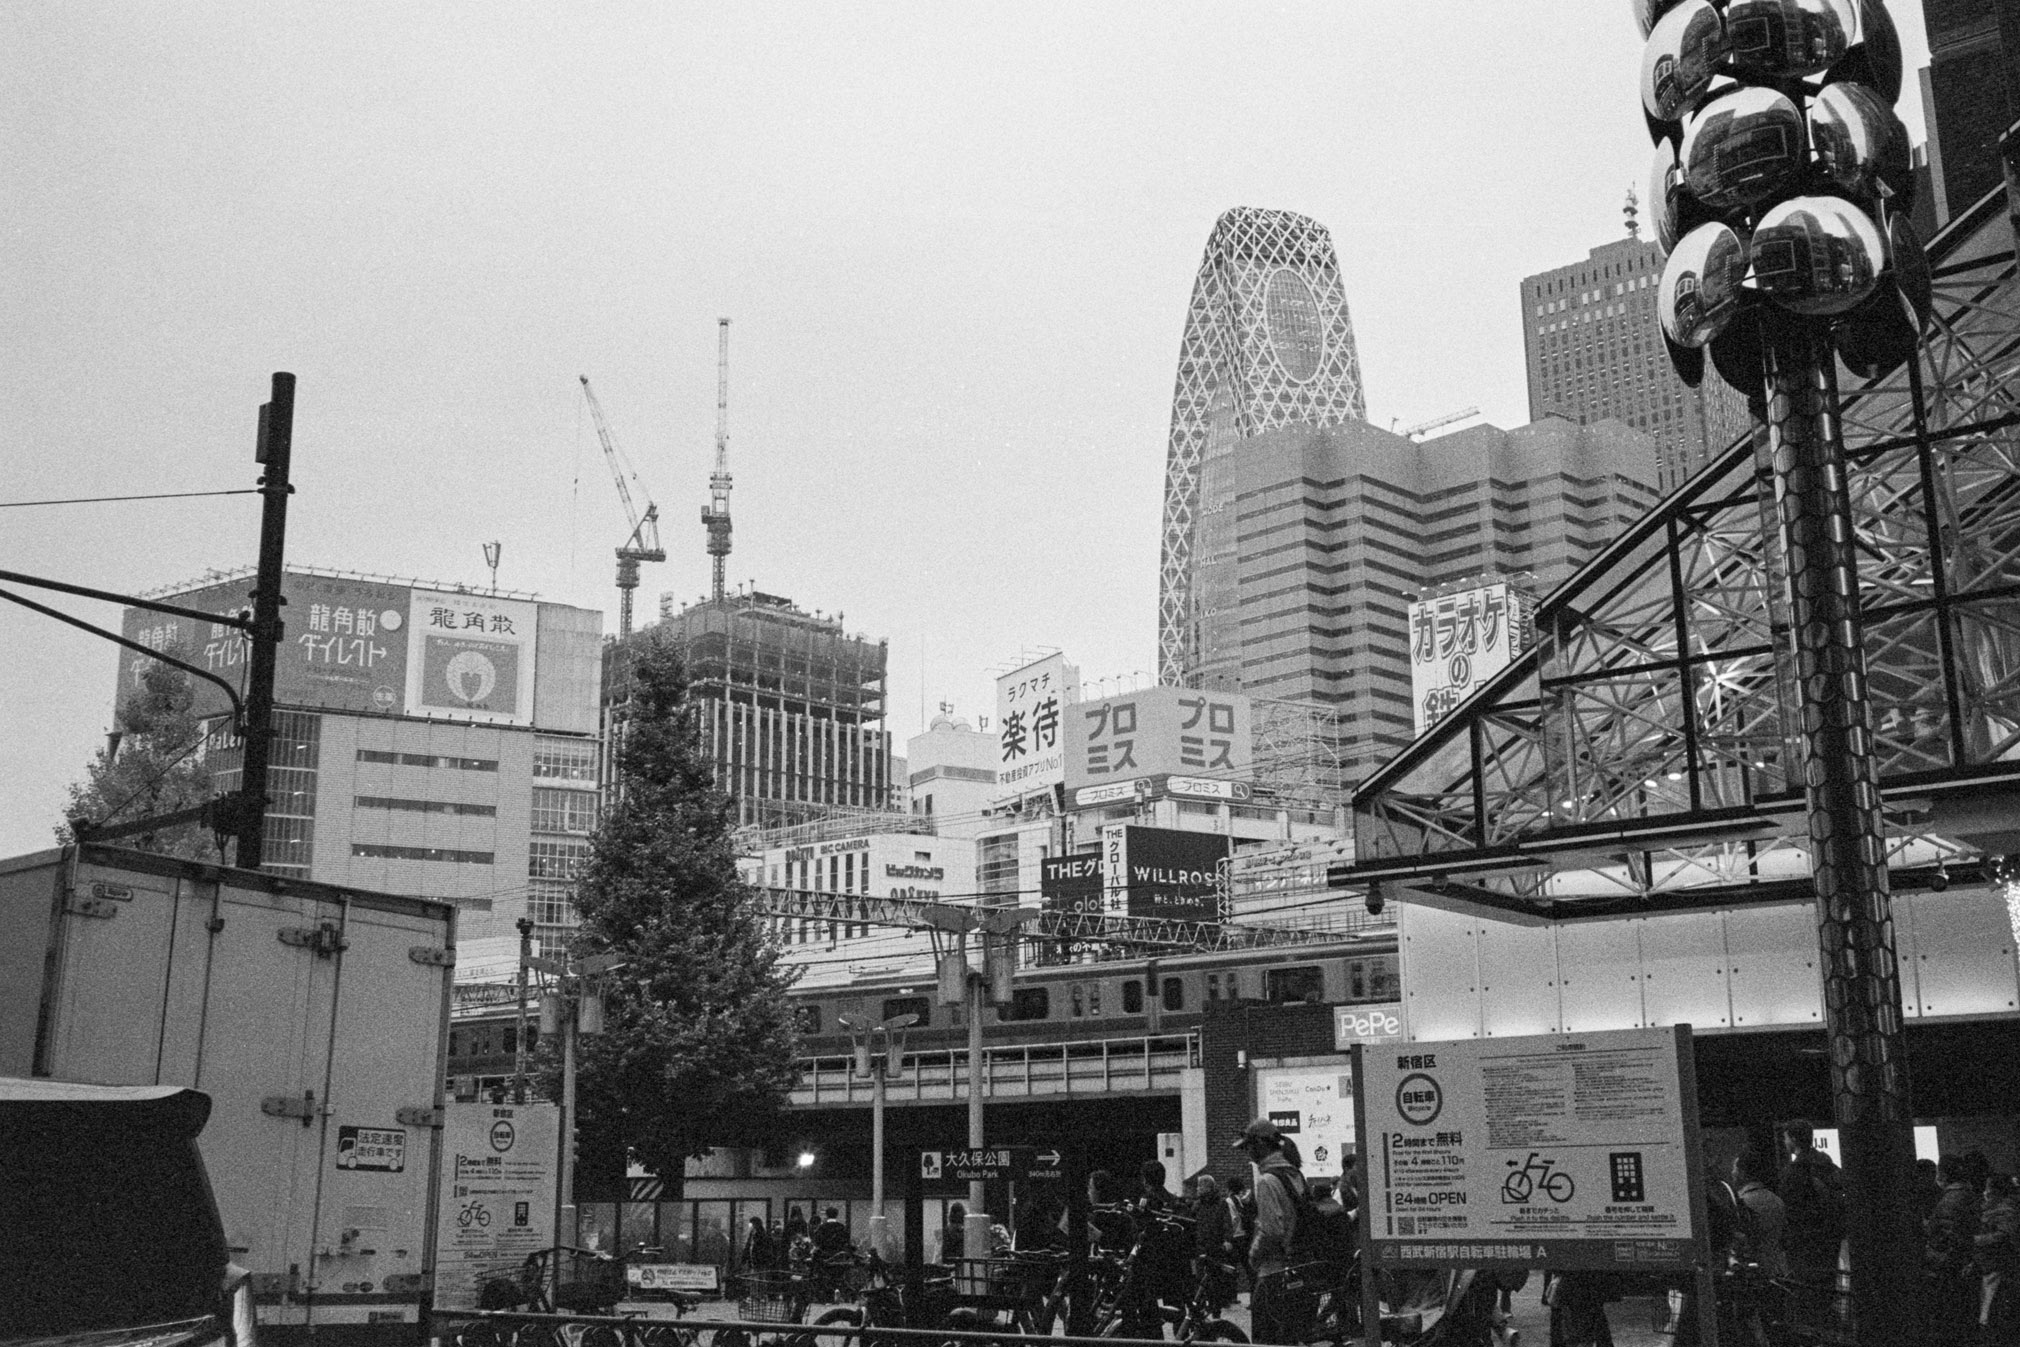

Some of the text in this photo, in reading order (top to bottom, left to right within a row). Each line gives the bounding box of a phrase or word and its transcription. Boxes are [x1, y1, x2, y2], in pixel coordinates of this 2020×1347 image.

[310, 603, 377, 637] 龍角散
[430, 607, 516, 635] 龍角散
[1412, 589, 1505, 665] カラオケ
[1449, 651, 1472, 689] の
[1008, 672, 1051, 703] ラクマチ
[1001, 696, 1060, 763] 楽待
[1090, 789, 1125, 800] プロミス
[1184, 781, 1221, 794] プロミス
[835, 839, 870, 852] CAMERA
[886, 863, 944, 881] ビックカメラ
[1340, 1012, 1399, 1037] PePe
[1397, 1054, 1437, 1070] 新宿区
[1402, 1091, 1436, 1104] 自転車
[359, 1131, 404, 1146] 法定速度
[945, 1150, 1010, 1167] 大久保公園
[956, 1169, 999, 1179] Okubo Park
[1536, 1245, 1548, 1258] A
